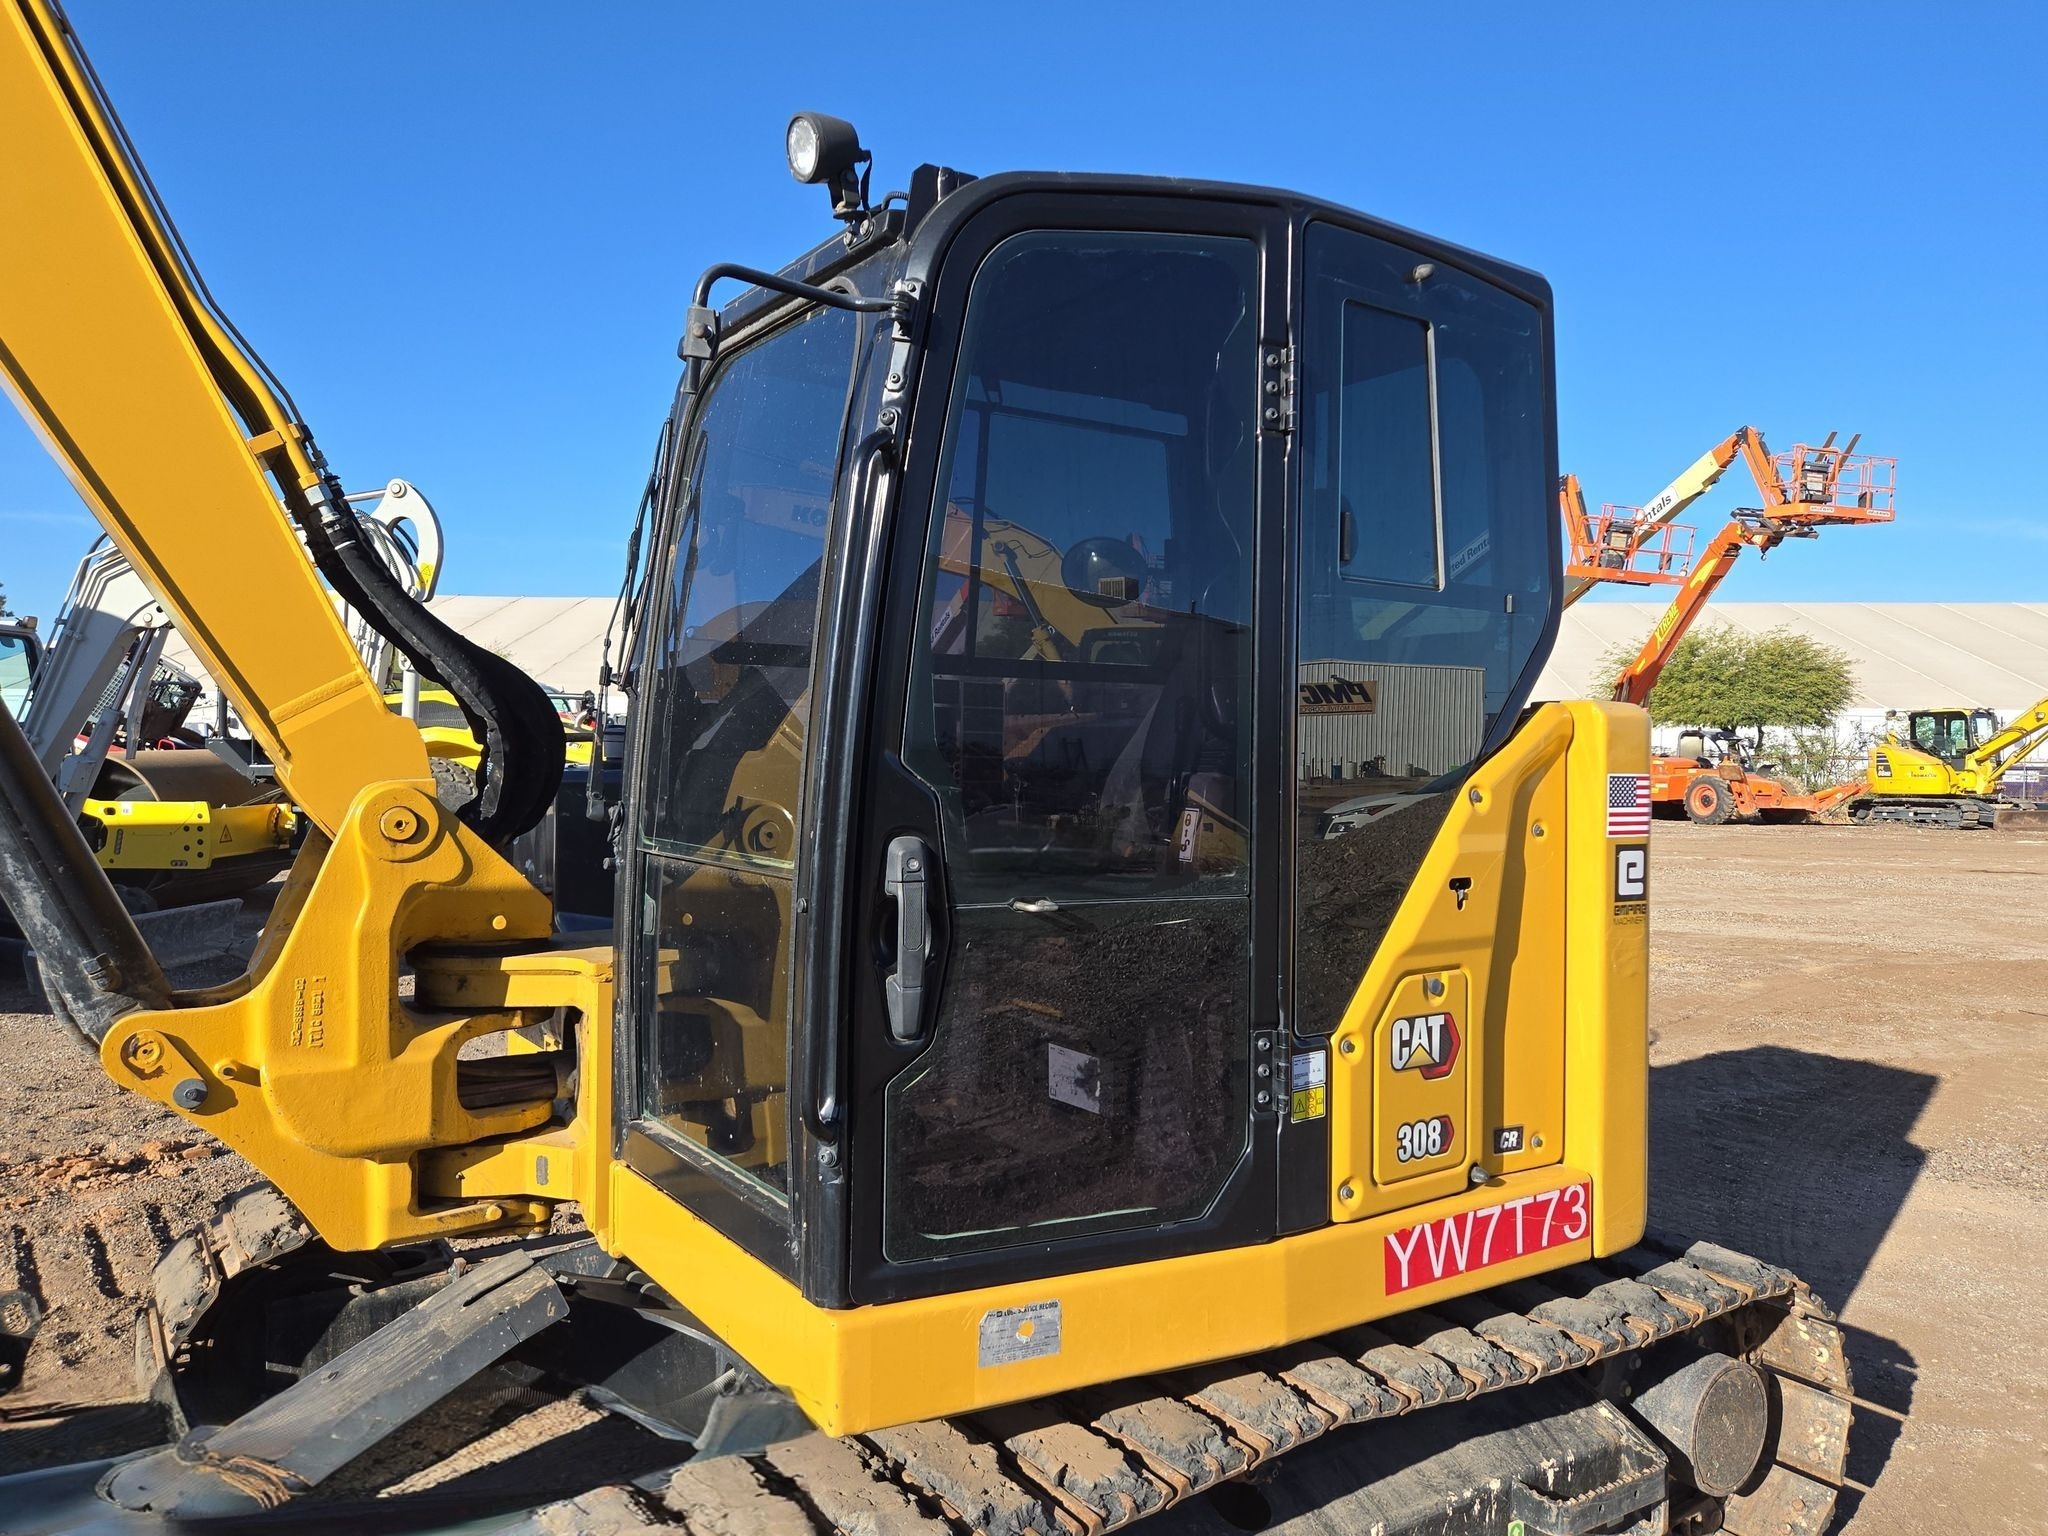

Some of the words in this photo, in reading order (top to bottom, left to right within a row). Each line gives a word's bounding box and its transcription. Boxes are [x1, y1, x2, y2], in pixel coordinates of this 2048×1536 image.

[1654, 600, 1680, 650] XTREME
[1392, 1013, 1446, 1070] CAT
[1397, 1118, 1442, 1162] 308
[1500, 1130, 1519, 1149] CR
[1386, 1184, 1588, 1289] YW7T73
